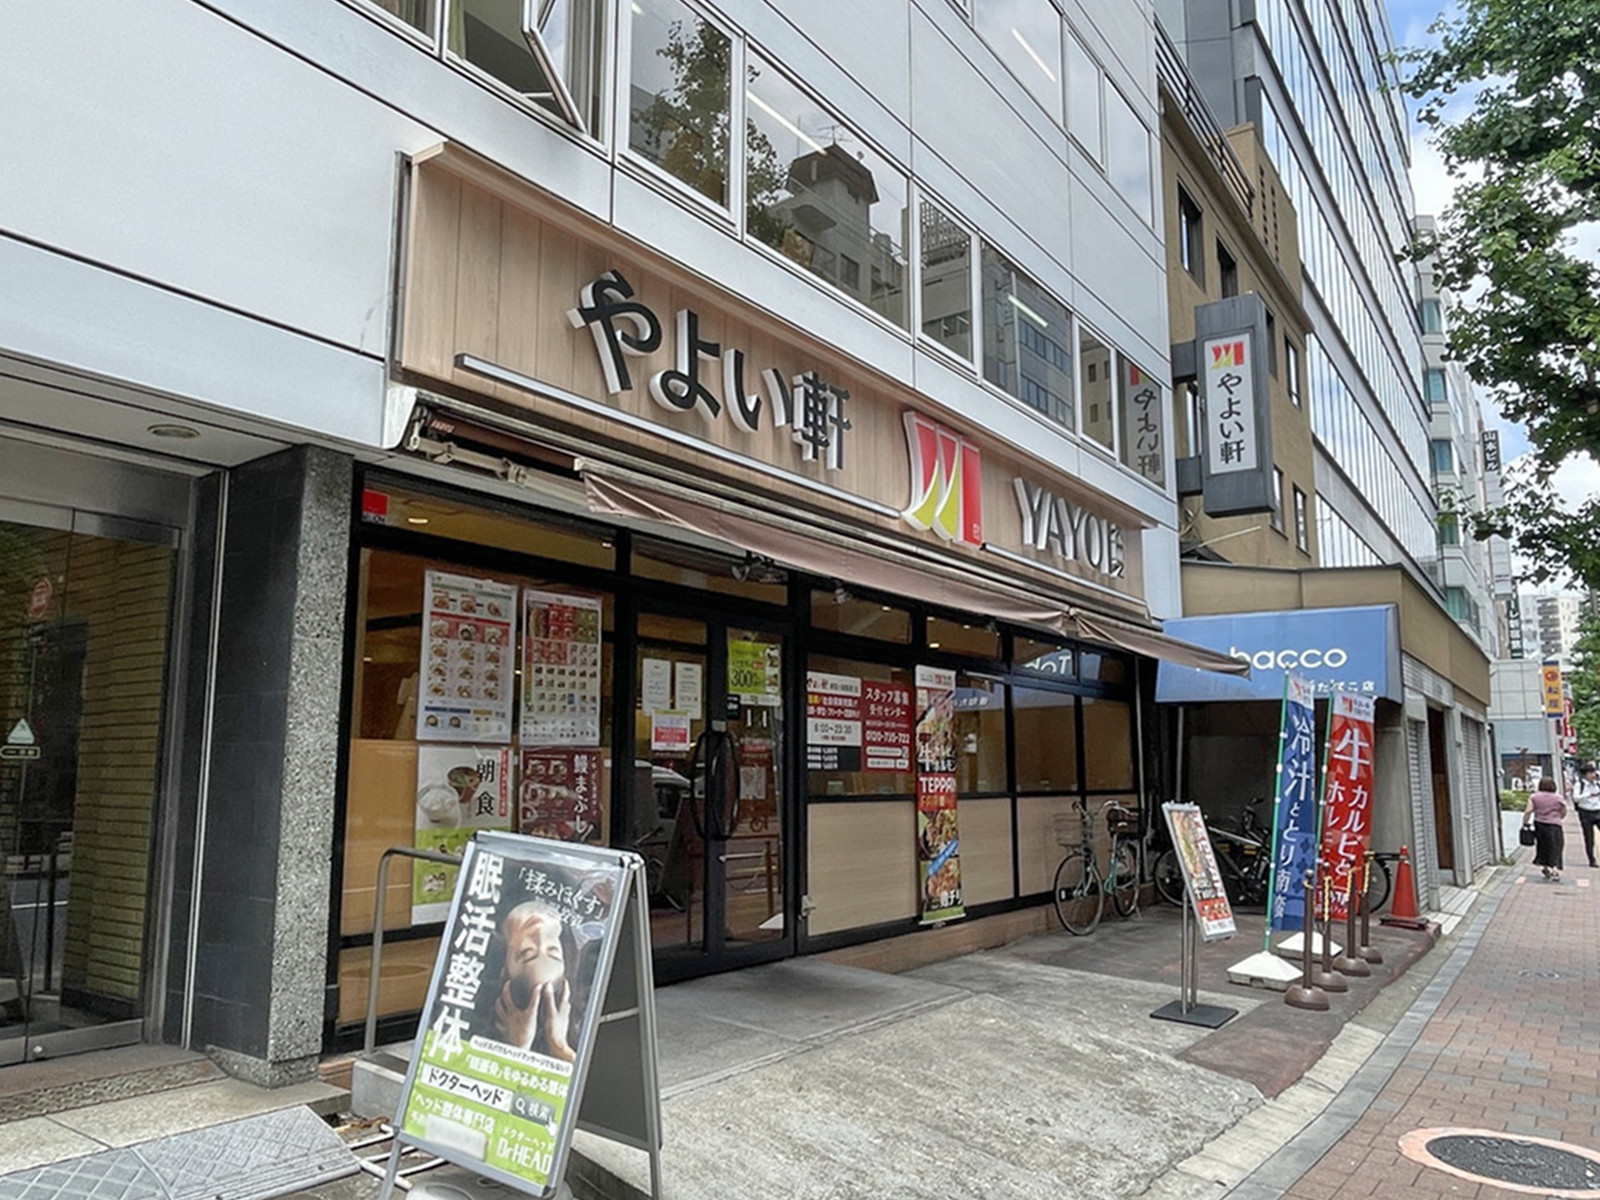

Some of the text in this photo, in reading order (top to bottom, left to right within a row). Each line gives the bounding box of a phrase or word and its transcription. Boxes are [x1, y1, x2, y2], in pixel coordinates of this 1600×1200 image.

[567, 268, 852, 471] やよい軒
[1217, 372, 1246, 465] やよい軒
[1013, 477, 1112, 575] YAYOI
[475, 758, 496, 818] 朝食
[1332, 728, 1370, 780] 牛
[1334, 784, 1368, 876] カルビと
[424, 851, 505, 1063] 眠活整体
[415, 1093, 496, 1134] ヘッド整体専門店
[428, 1066, 504, 1106] ドクターヘッド
[495, 1137, 553, 1175] DrHEAD
